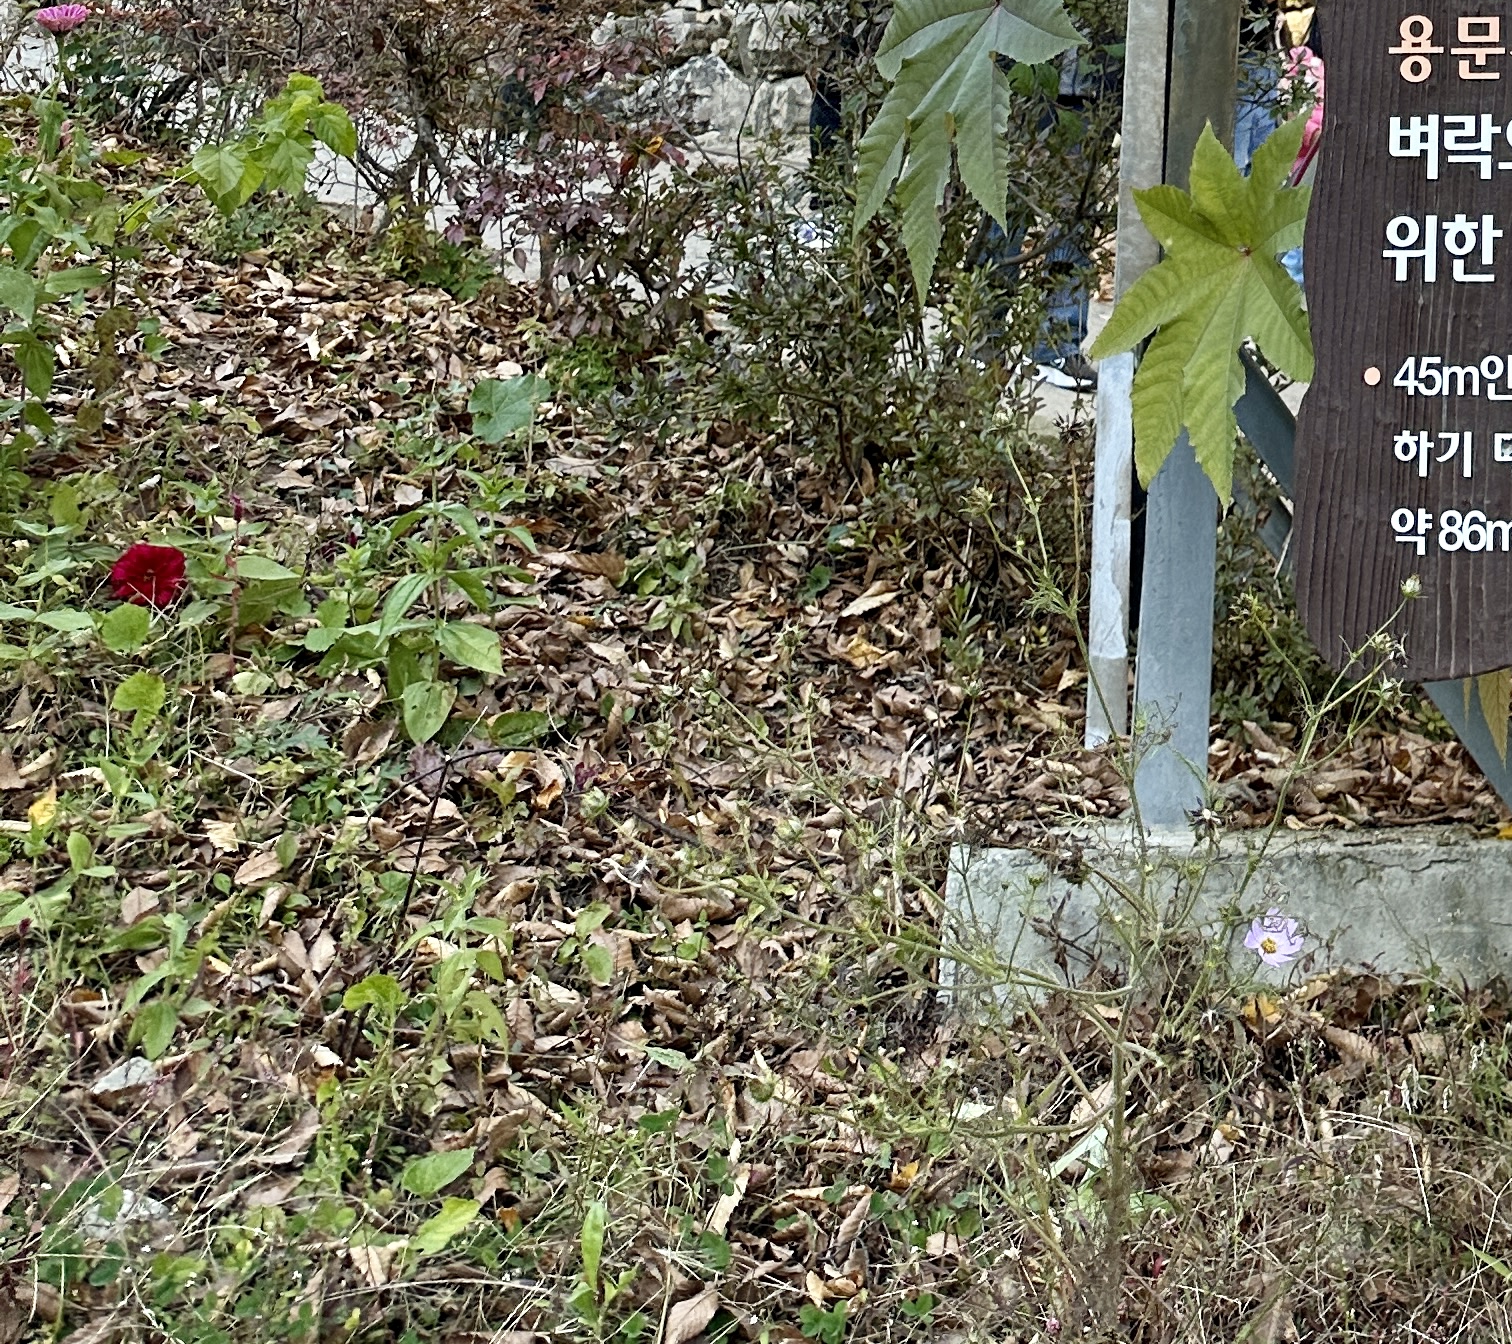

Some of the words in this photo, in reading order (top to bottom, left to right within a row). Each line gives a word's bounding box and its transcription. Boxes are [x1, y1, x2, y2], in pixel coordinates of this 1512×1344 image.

[1382, 213, 1504, 283] 위한
[1393, 429, 1473, 478] 하기
[1390, 507, 1433, 556] 약
